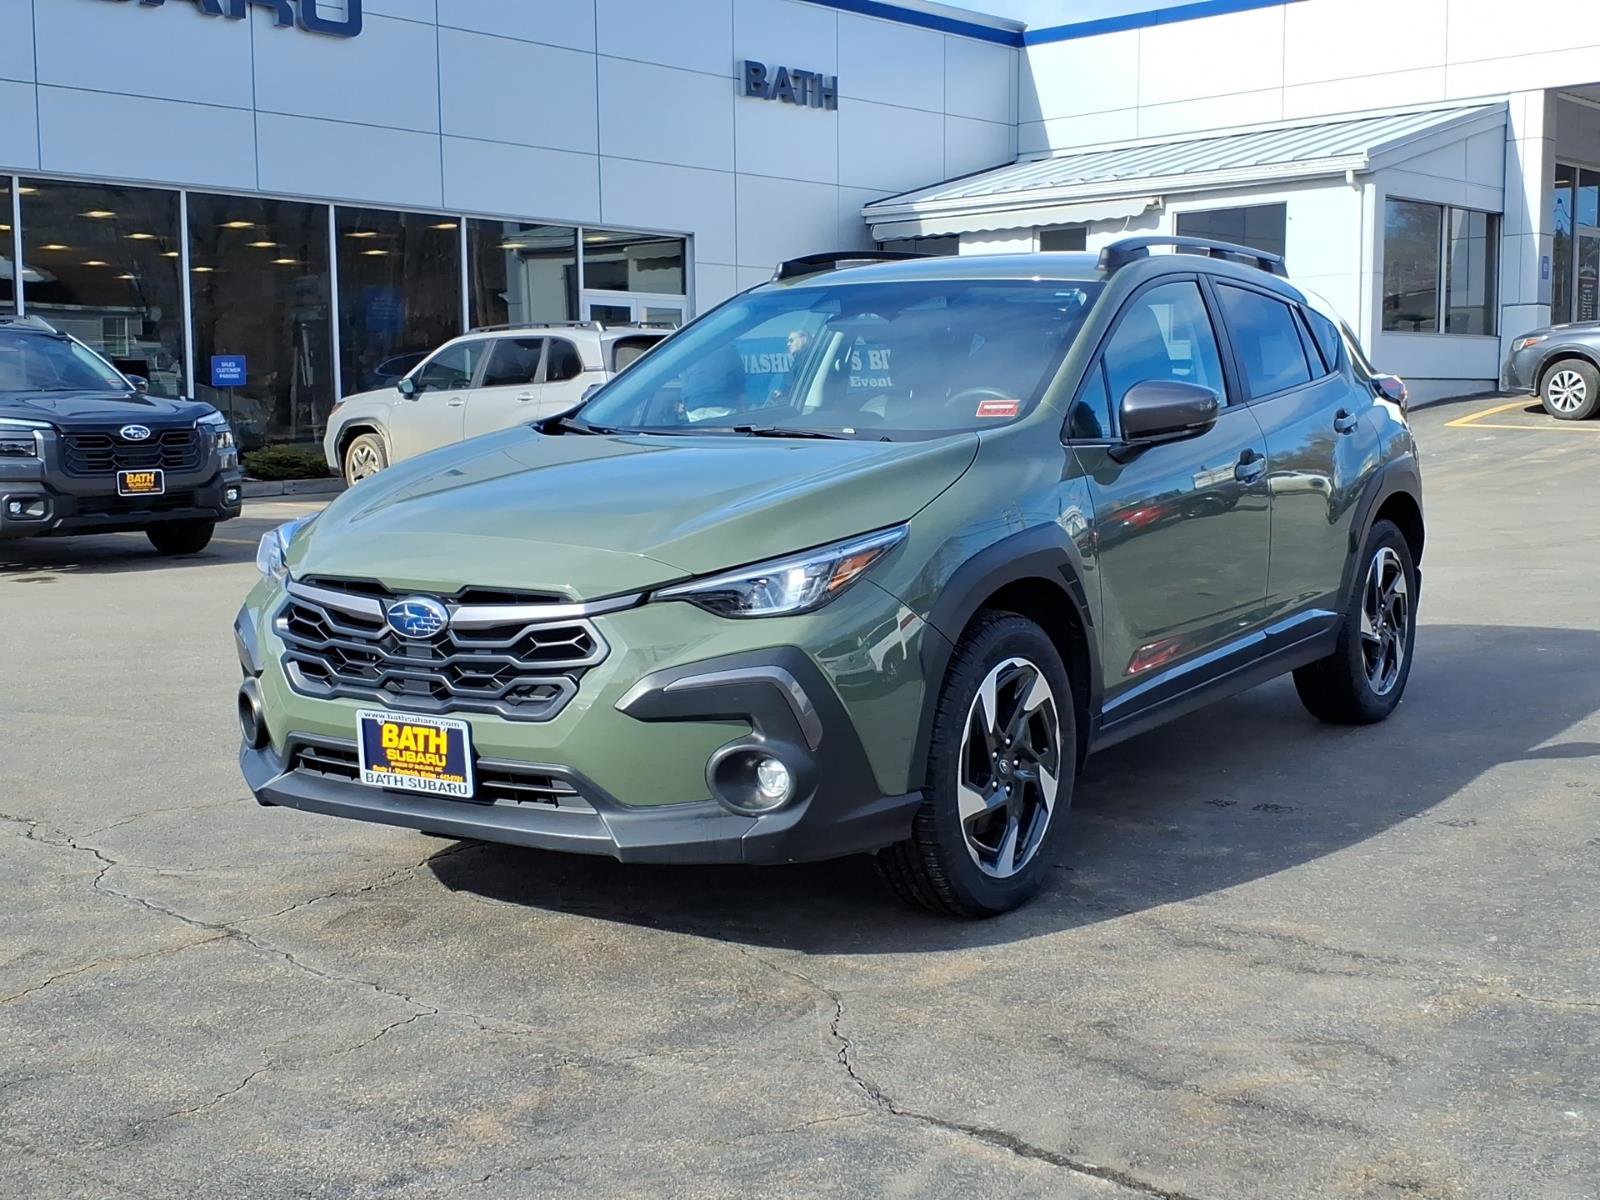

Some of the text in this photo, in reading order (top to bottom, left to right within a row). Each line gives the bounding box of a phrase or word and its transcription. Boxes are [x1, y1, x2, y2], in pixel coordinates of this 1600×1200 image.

[742, 59, 838, 111] BATH
[849, 375, 894, 388] Event
[126, 473, 155, 484] BATH
[381, 722, 449, 755] BATH
[385, 748, 447, 768] SUBARU
[365, 772, 405, 787] BATH
[408, 777, 469, 796] SUBARU
